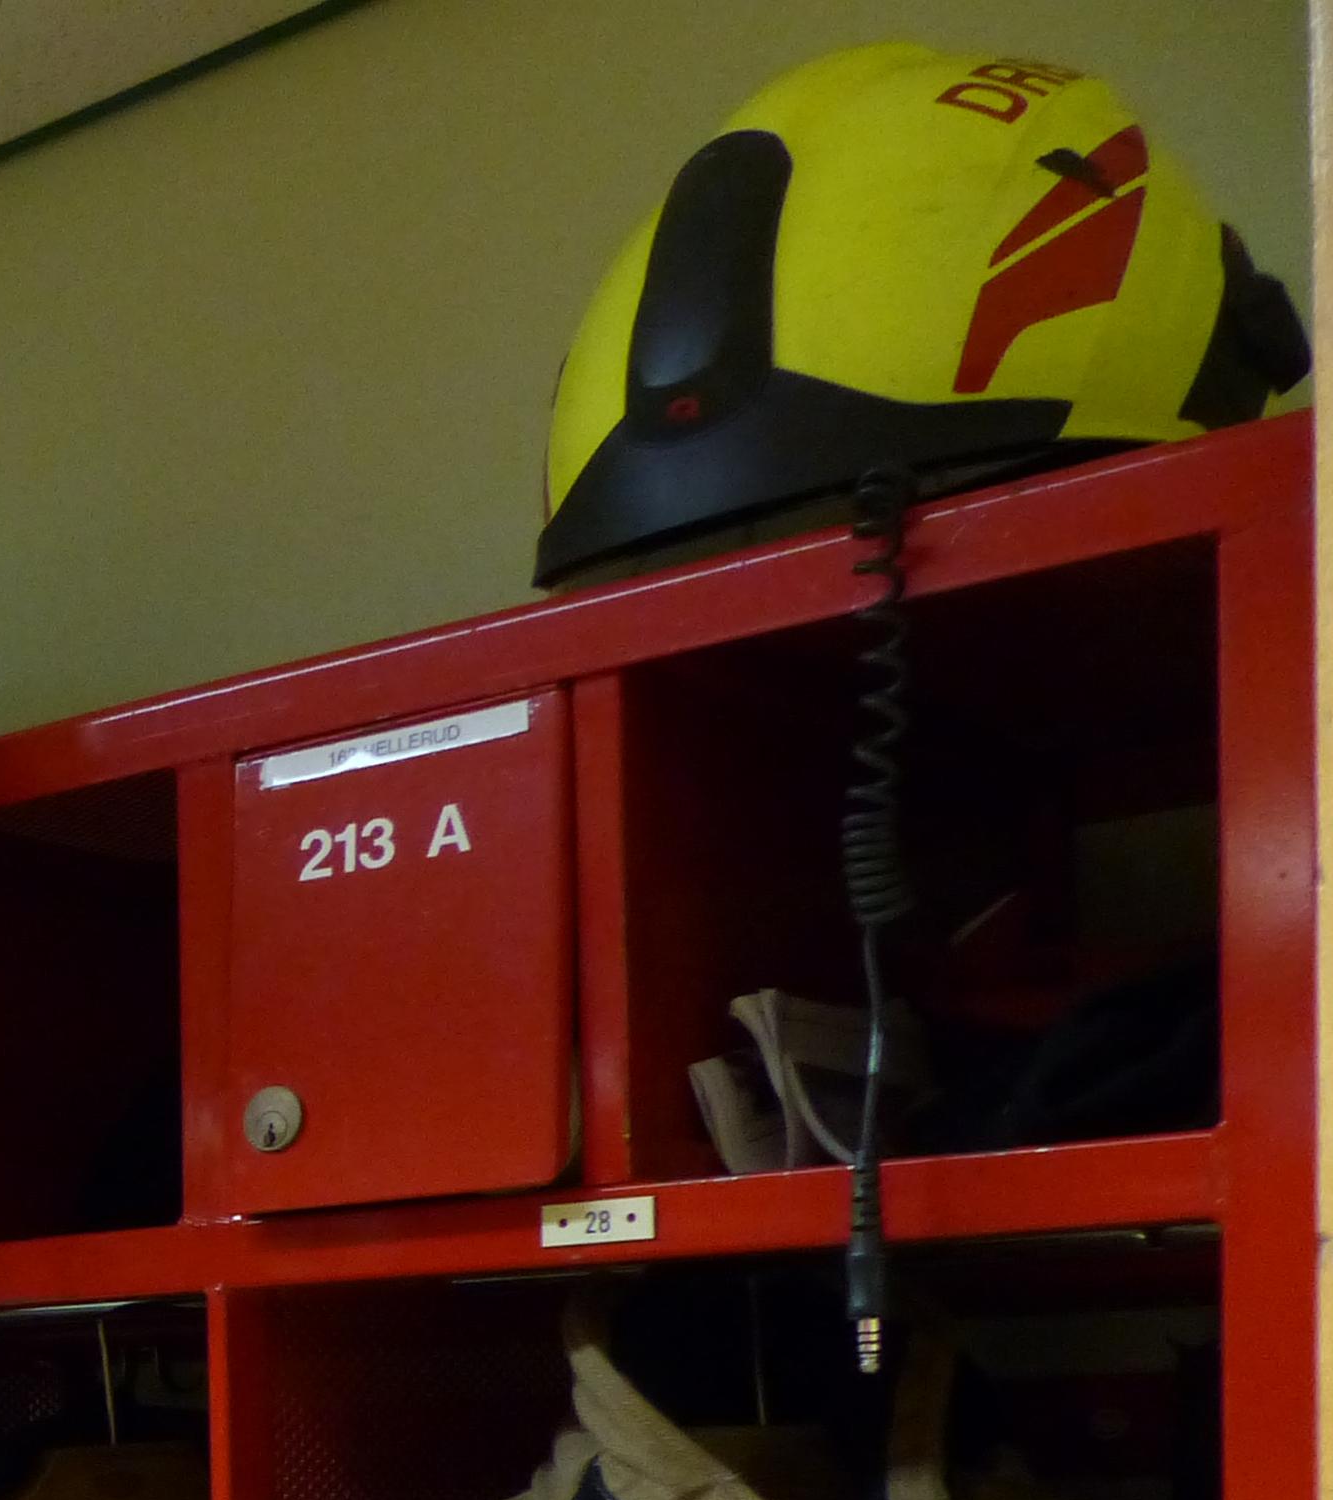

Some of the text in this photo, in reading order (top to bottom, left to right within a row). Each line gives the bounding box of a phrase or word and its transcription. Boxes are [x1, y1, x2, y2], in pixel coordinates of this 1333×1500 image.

[299, 804, 471, 881] 213 A
[585, 1210, 611, 1234] 28
